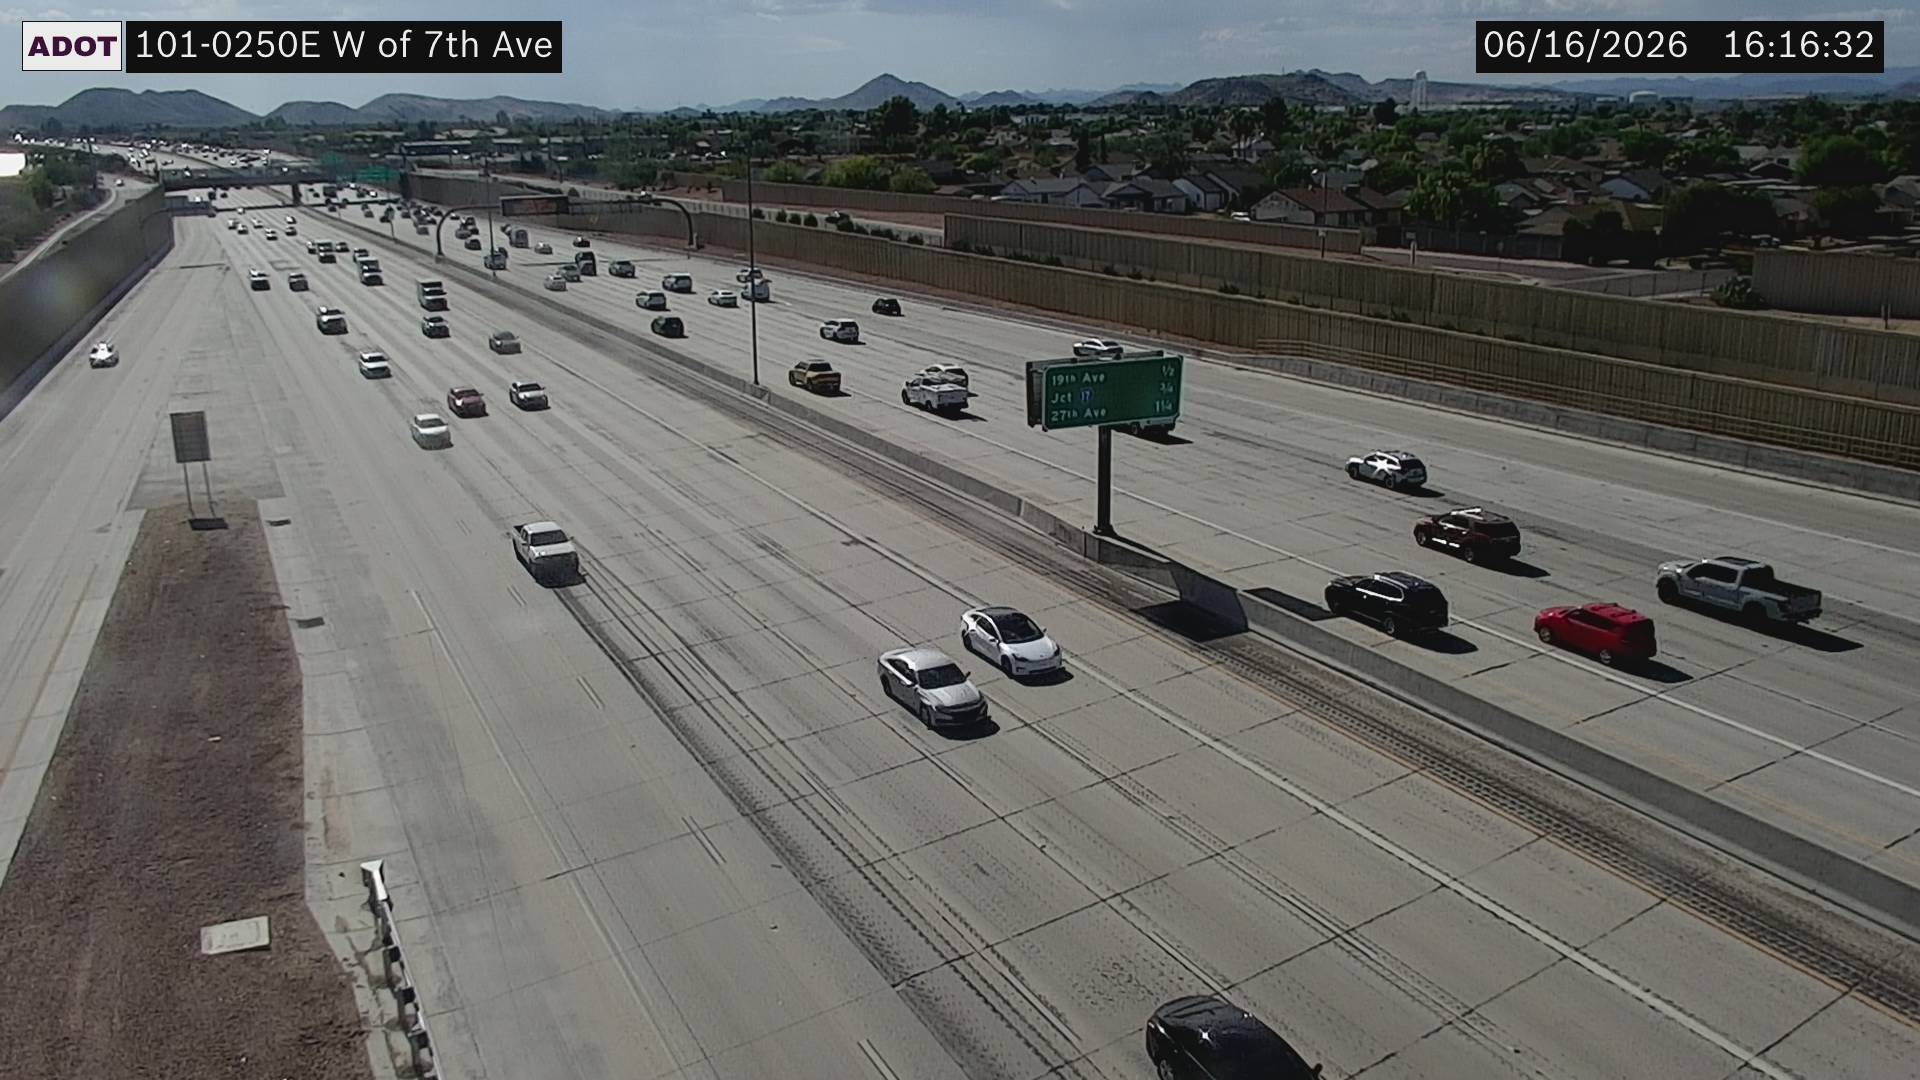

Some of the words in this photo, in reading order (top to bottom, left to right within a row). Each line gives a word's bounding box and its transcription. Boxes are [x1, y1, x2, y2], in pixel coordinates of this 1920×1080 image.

[1052, 374, 1076, 386] 19th
[1082, 372, 1105, 383] Ave
[1051, 392, 1072, 404] Jct
[1051, 408, 1078, 421] 27th
[1083, 407, 1106, 419] Ave
